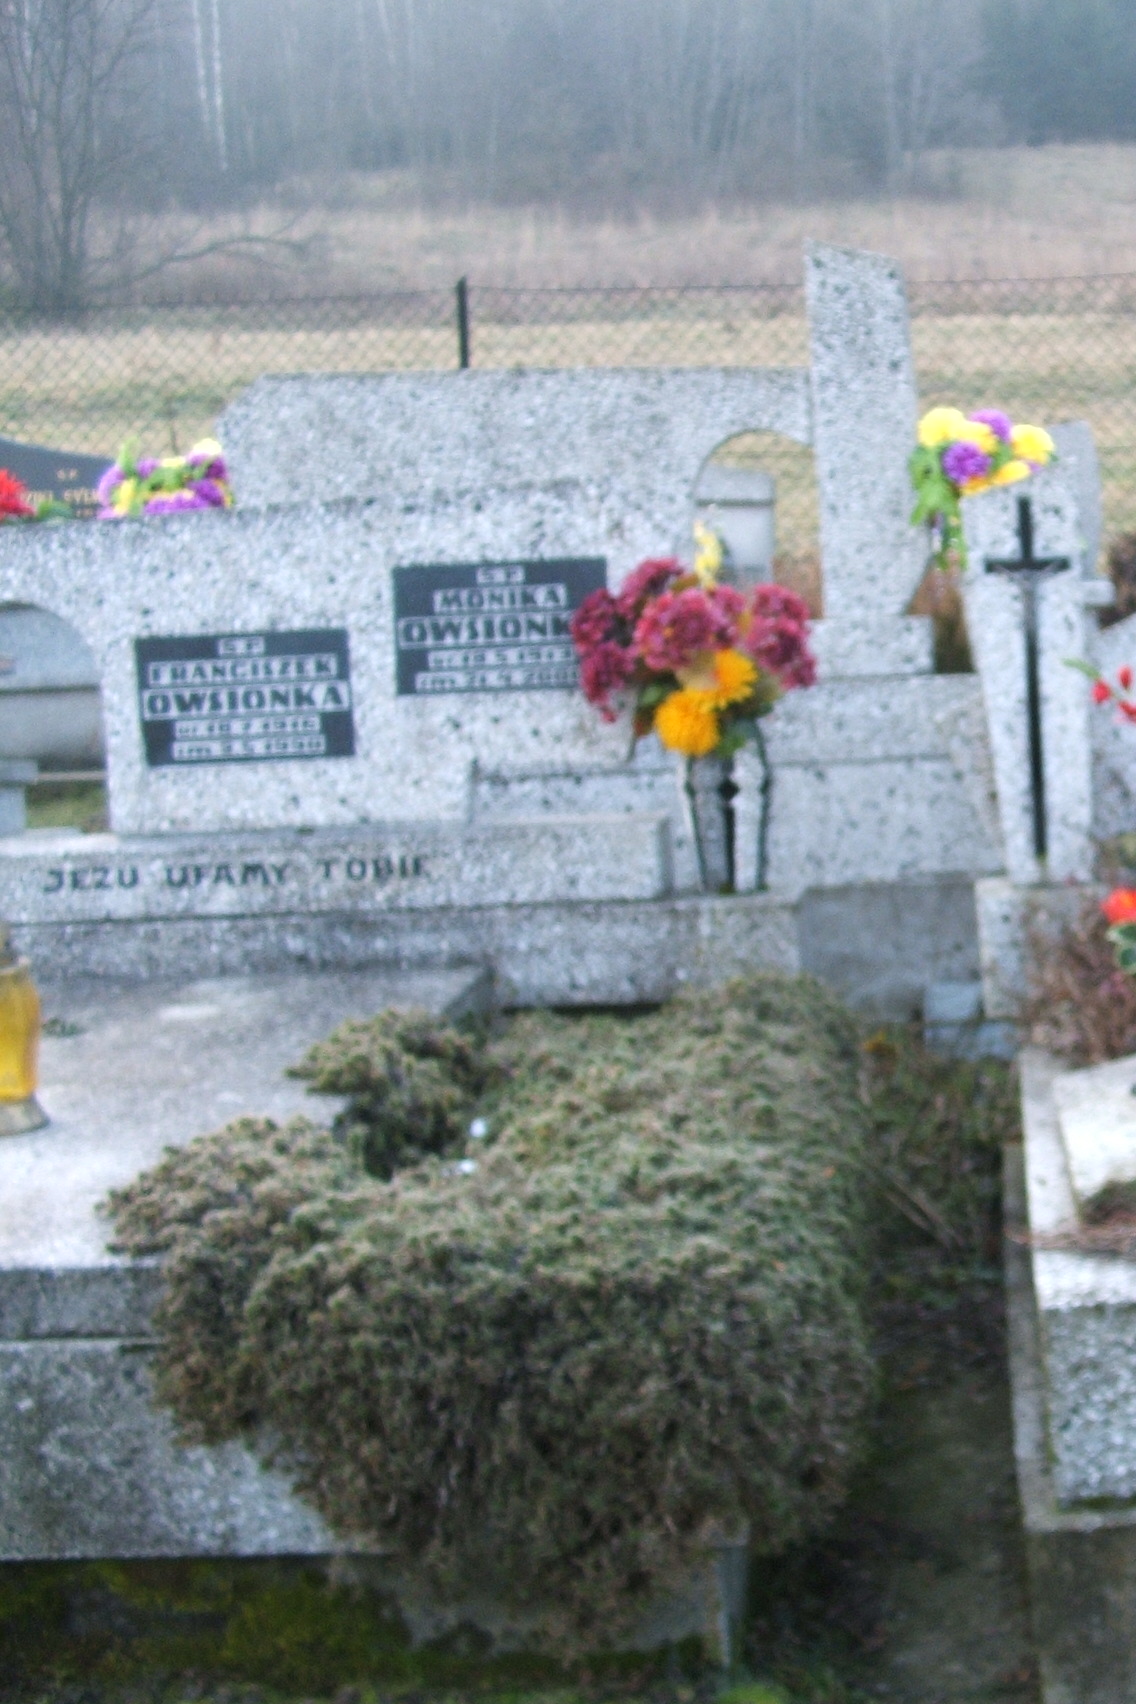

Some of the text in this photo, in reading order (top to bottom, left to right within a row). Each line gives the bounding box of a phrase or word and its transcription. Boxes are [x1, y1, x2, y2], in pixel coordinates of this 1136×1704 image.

[440, 587, 561, 606] MONIKA
[402, 616, 573, 641] OWSIONK
[146, 685, 344, 714] OWSIONKA
[42, 853, 430, 893] JEZU UFAMY TOBIE
